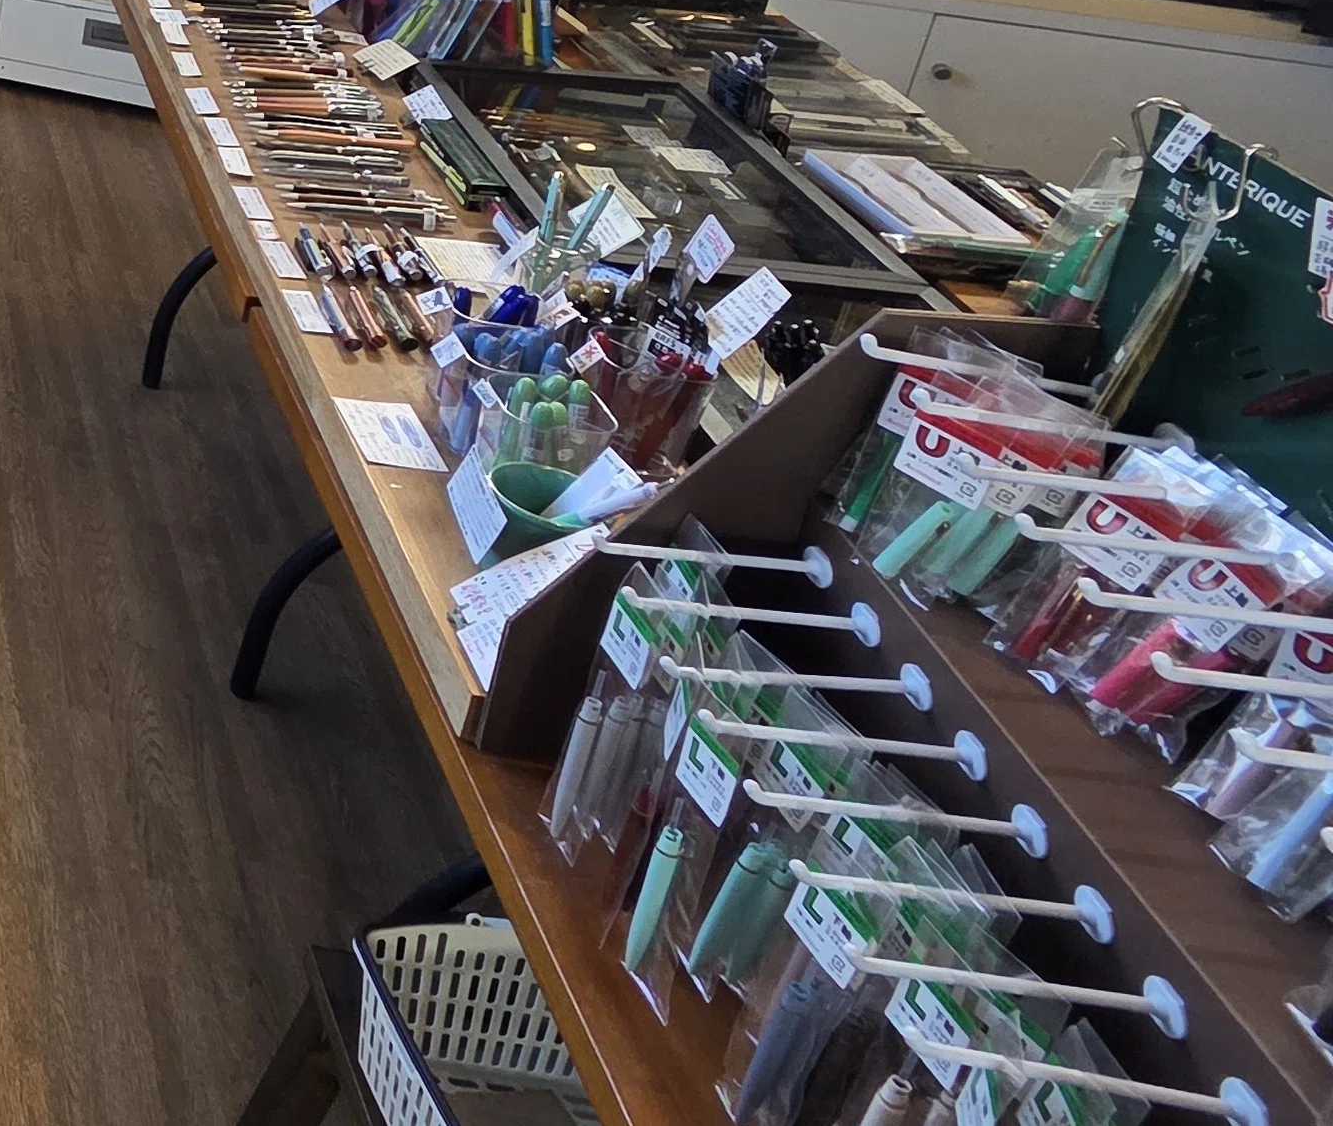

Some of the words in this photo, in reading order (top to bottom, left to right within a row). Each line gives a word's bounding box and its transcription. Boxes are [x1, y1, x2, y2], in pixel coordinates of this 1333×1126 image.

[1190, 145, 1312, 229] ANTERIQUE
[915, 424, 951, 458] U
[1086, 499, 1129, 535] U
[1188, 559, 1229, 592] U
[612, 609, 626, 641] L
[688, 737, 704, 774] L
[770, 740, 788, 778] L
[832, 816, 853, 857] L
[802, 886, 824, 925] L
[904, 978, 926, 1022] L
[1034, 1079, 1055, 1123] L
